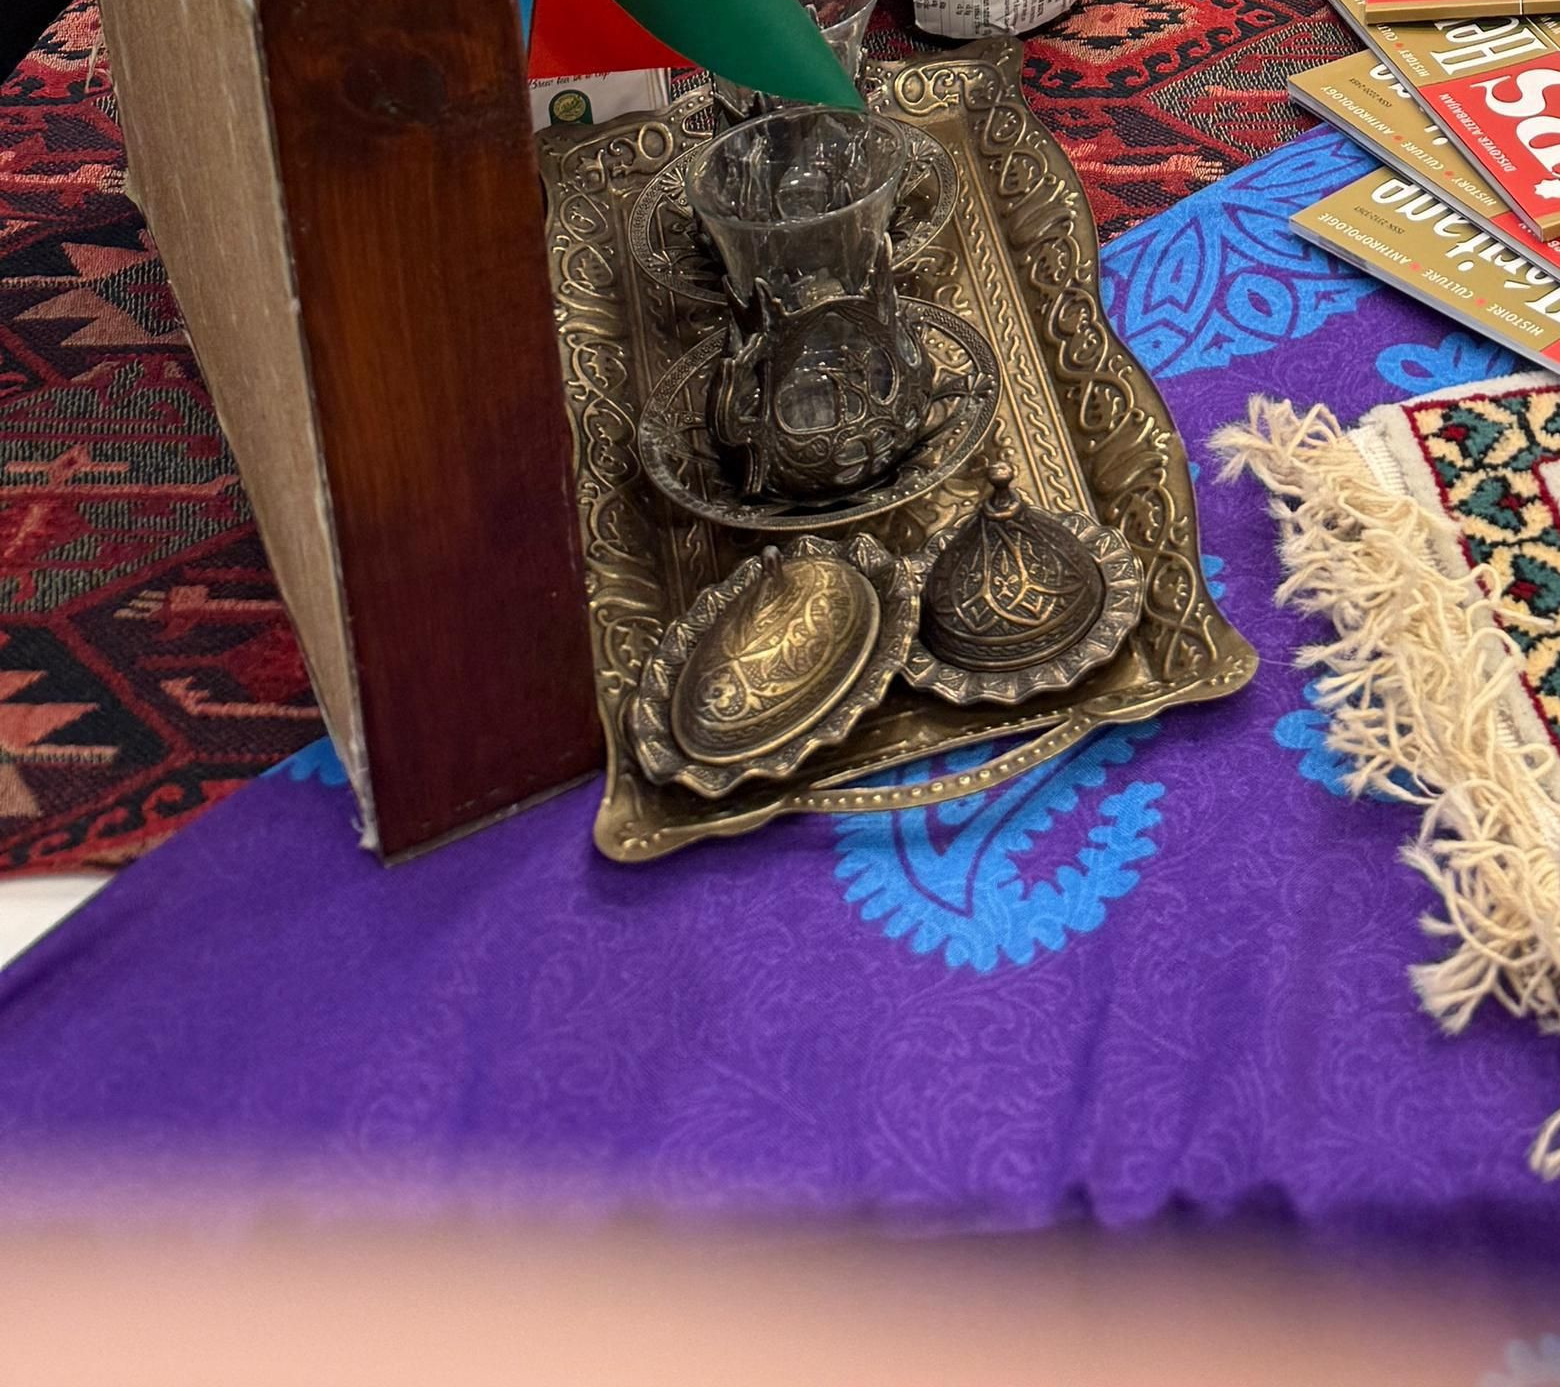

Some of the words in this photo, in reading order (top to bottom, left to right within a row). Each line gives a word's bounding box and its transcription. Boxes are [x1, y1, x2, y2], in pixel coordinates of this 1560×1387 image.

[1399, 50, 1431, 77] HISTORY
[1320, 85, 1396, 136] ANTHROPOLOGY
[1438, 93, 1485, 138] AZERBAIJAN
[1400, 141, 1446, 172] CULTURE
[1478, 136, 1518, 173] DISCOVER
[1451, 177, 1498, 208] HISTORY
[1317, 212, 1412, 265] ANTHROPOLOGIE
[1421, 268, 1475, 300] CULTURE
[1485, 302, 1545, 338] HISTOIRE
